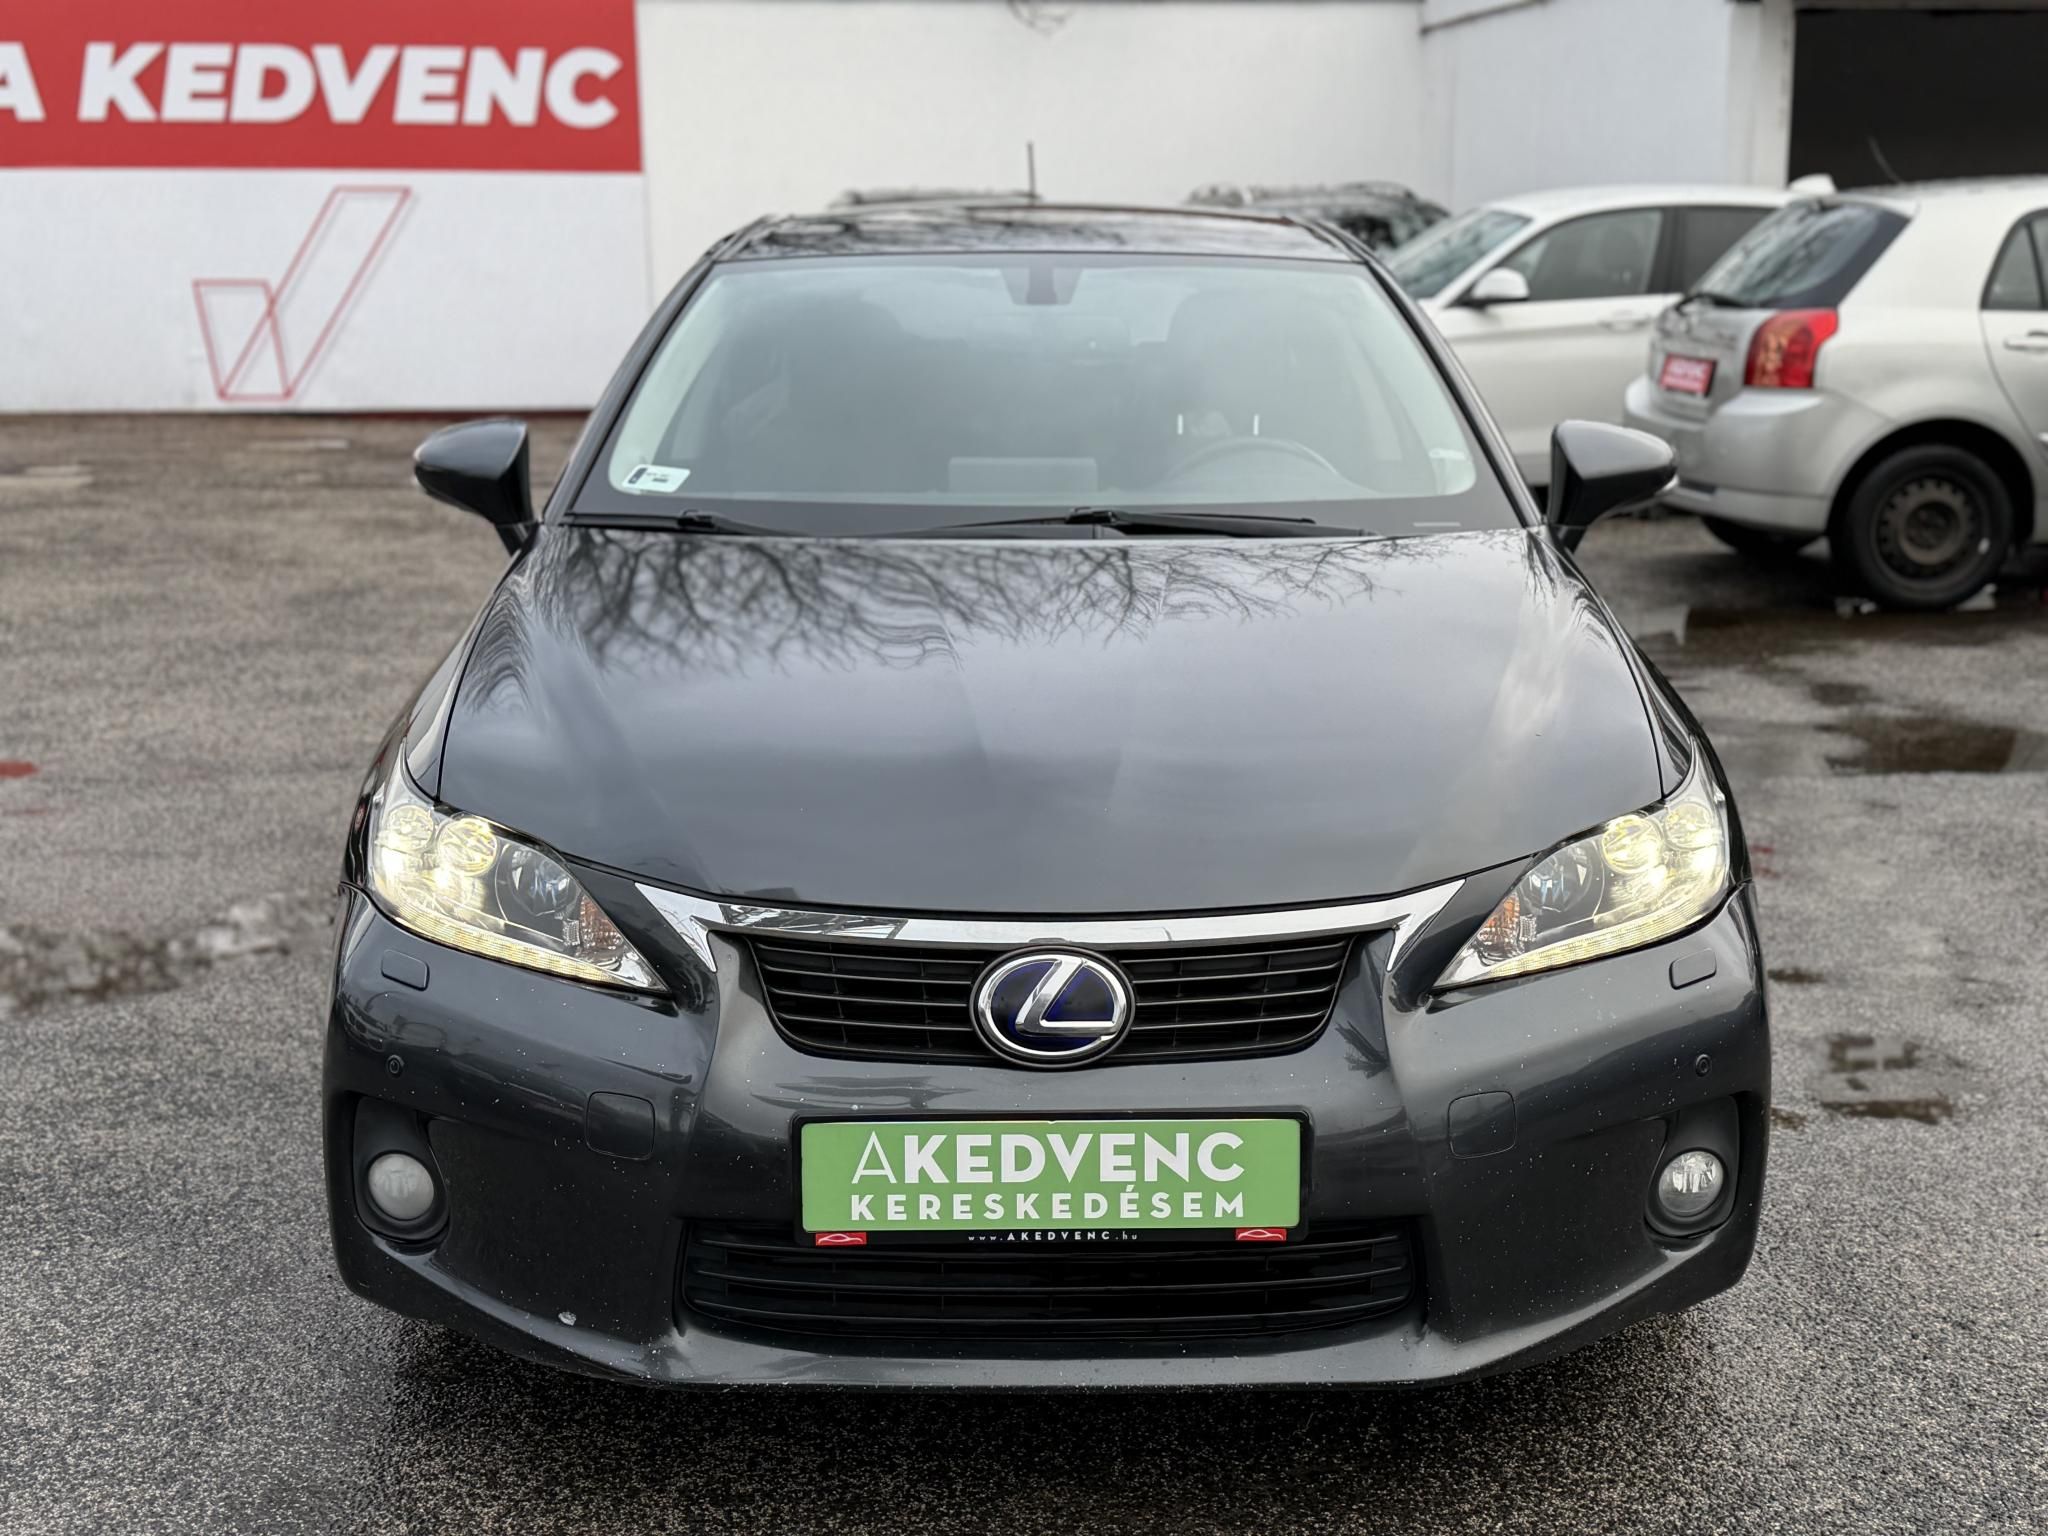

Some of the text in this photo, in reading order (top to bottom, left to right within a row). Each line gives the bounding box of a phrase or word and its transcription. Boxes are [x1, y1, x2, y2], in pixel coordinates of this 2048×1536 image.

[78, 42, 622, 128] KEDVENC
[851, 1131, 1245, 1184] AKEDVENC
[851, 1185, 1245, 1221] KERESKEDÉSEM
[968, 1231, 1138, 1241] www.AKEDVENC.hu
